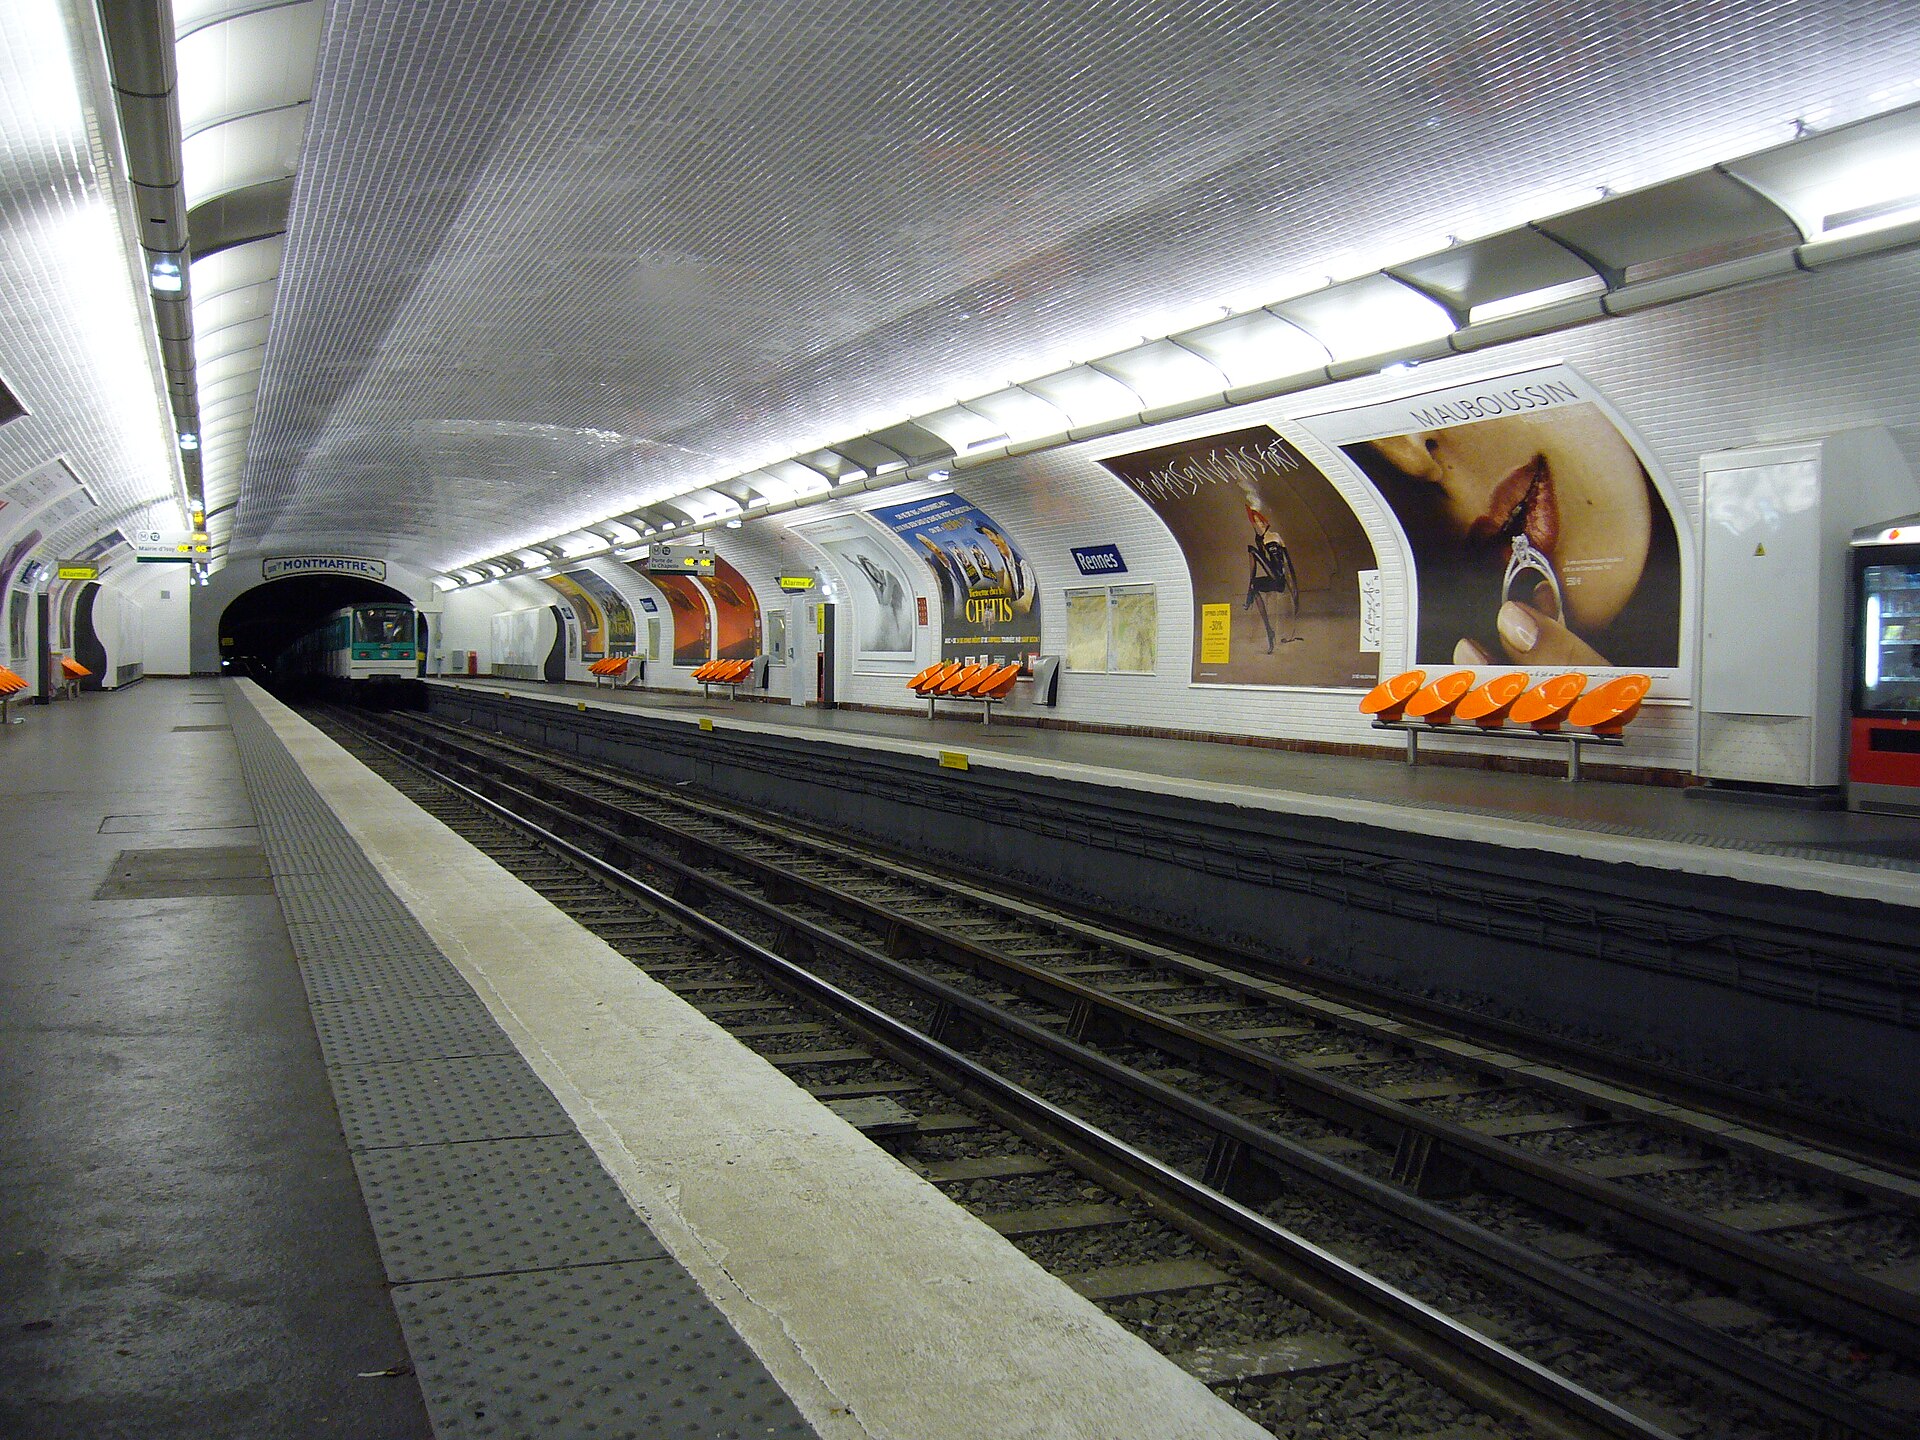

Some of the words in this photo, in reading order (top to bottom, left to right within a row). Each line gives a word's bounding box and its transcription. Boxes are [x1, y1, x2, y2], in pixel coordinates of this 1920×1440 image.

[1409, 380, 1580, 428] MAUBOUSSIN
[283, 559, 368, 572] MONTMARTRE
[1075, 552, 1119, 571] Rennes
